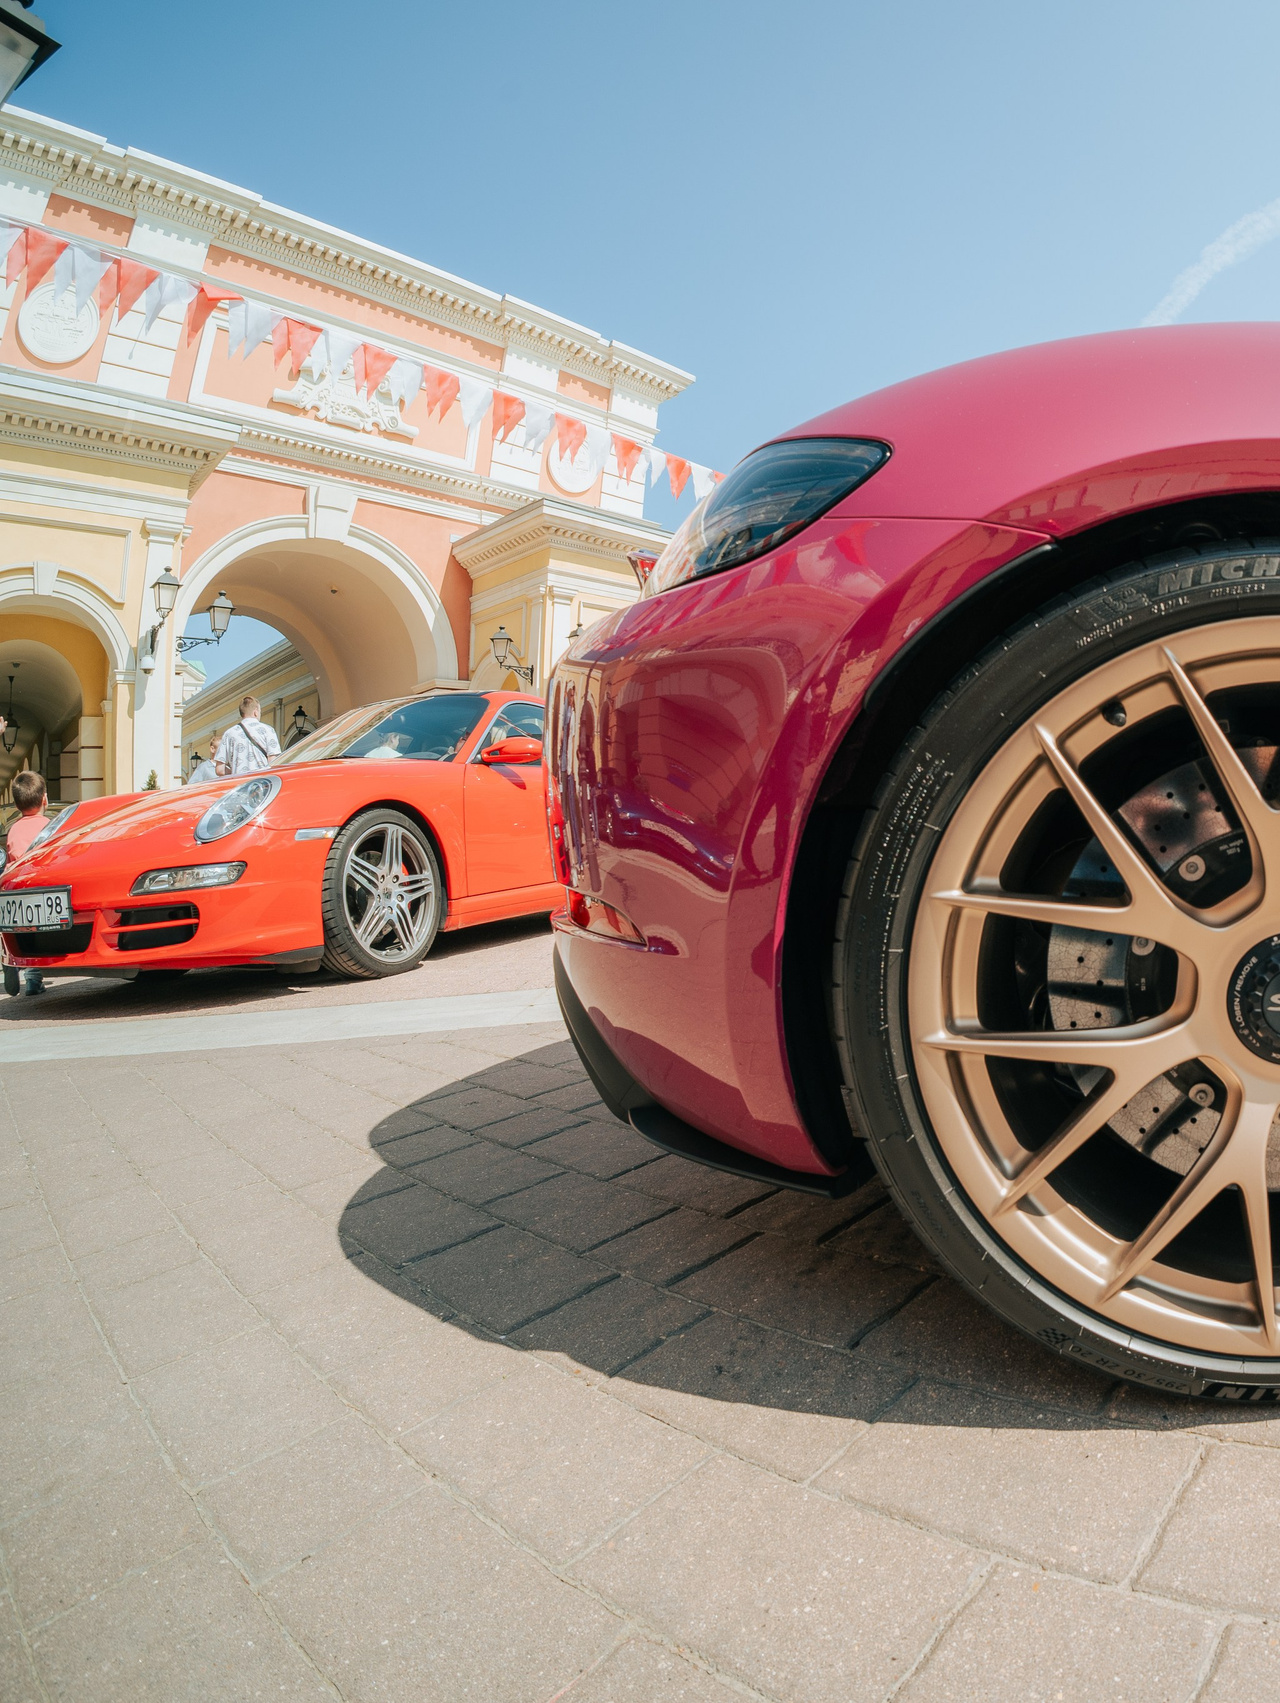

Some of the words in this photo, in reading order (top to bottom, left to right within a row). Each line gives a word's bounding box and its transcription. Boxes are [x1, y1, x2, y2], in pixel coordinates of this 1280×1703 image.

[46, 895, 63, 915] 98
[46, 915, 60, 923] RUS
[1234, 956, 1259, 991] REMOVE
[1071, 1344, 1092, 1358] 20
[1095, 1357, 1120, 1370] ZR
[1123, 1368, 1187, 1391] 295/30
